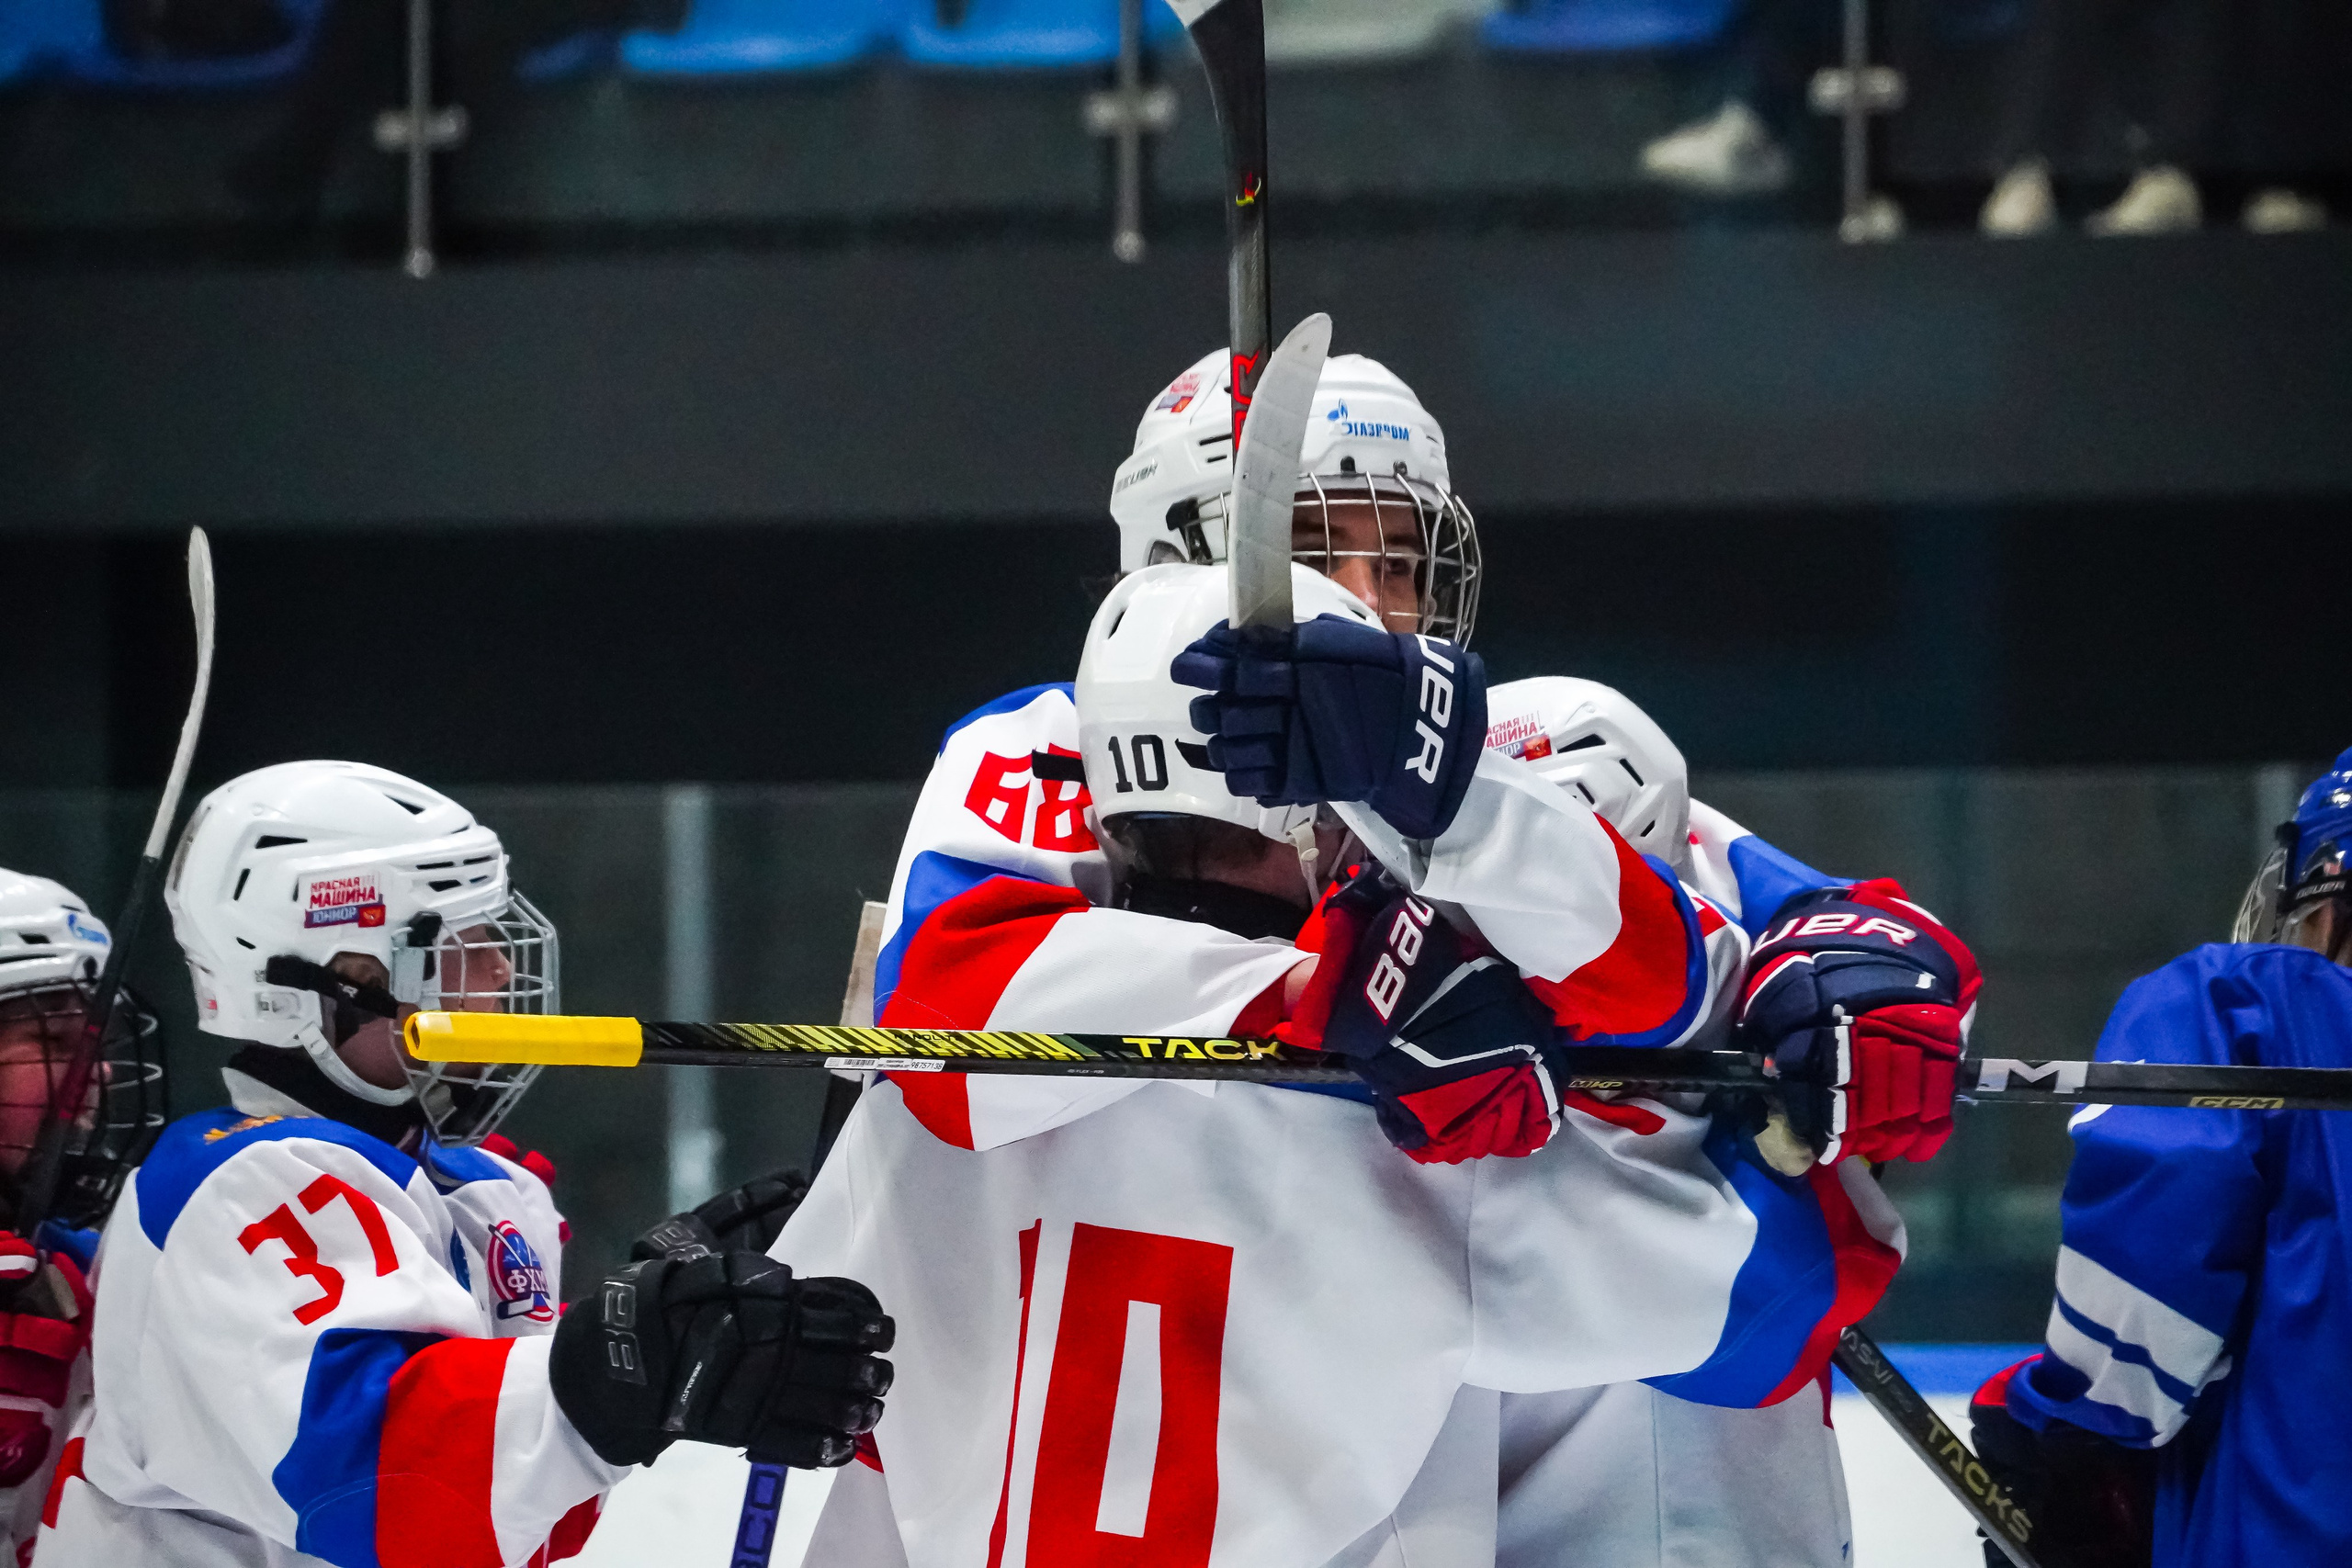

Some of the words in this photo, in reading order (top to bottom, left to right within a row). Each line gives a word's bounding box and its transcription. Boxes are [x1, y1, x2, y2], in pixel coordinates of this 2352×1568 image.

[1108, 735, 1169, 793] 10
[310, 886, 376, 908] МАШИНА
[311, 876, 360, 892] КРАСНАЯ
[312, 906, 357, 923] ЮНИОР
[237, 1173, 400, 1325] 37
[1927, 1412, 2033, 1543] TACKS
